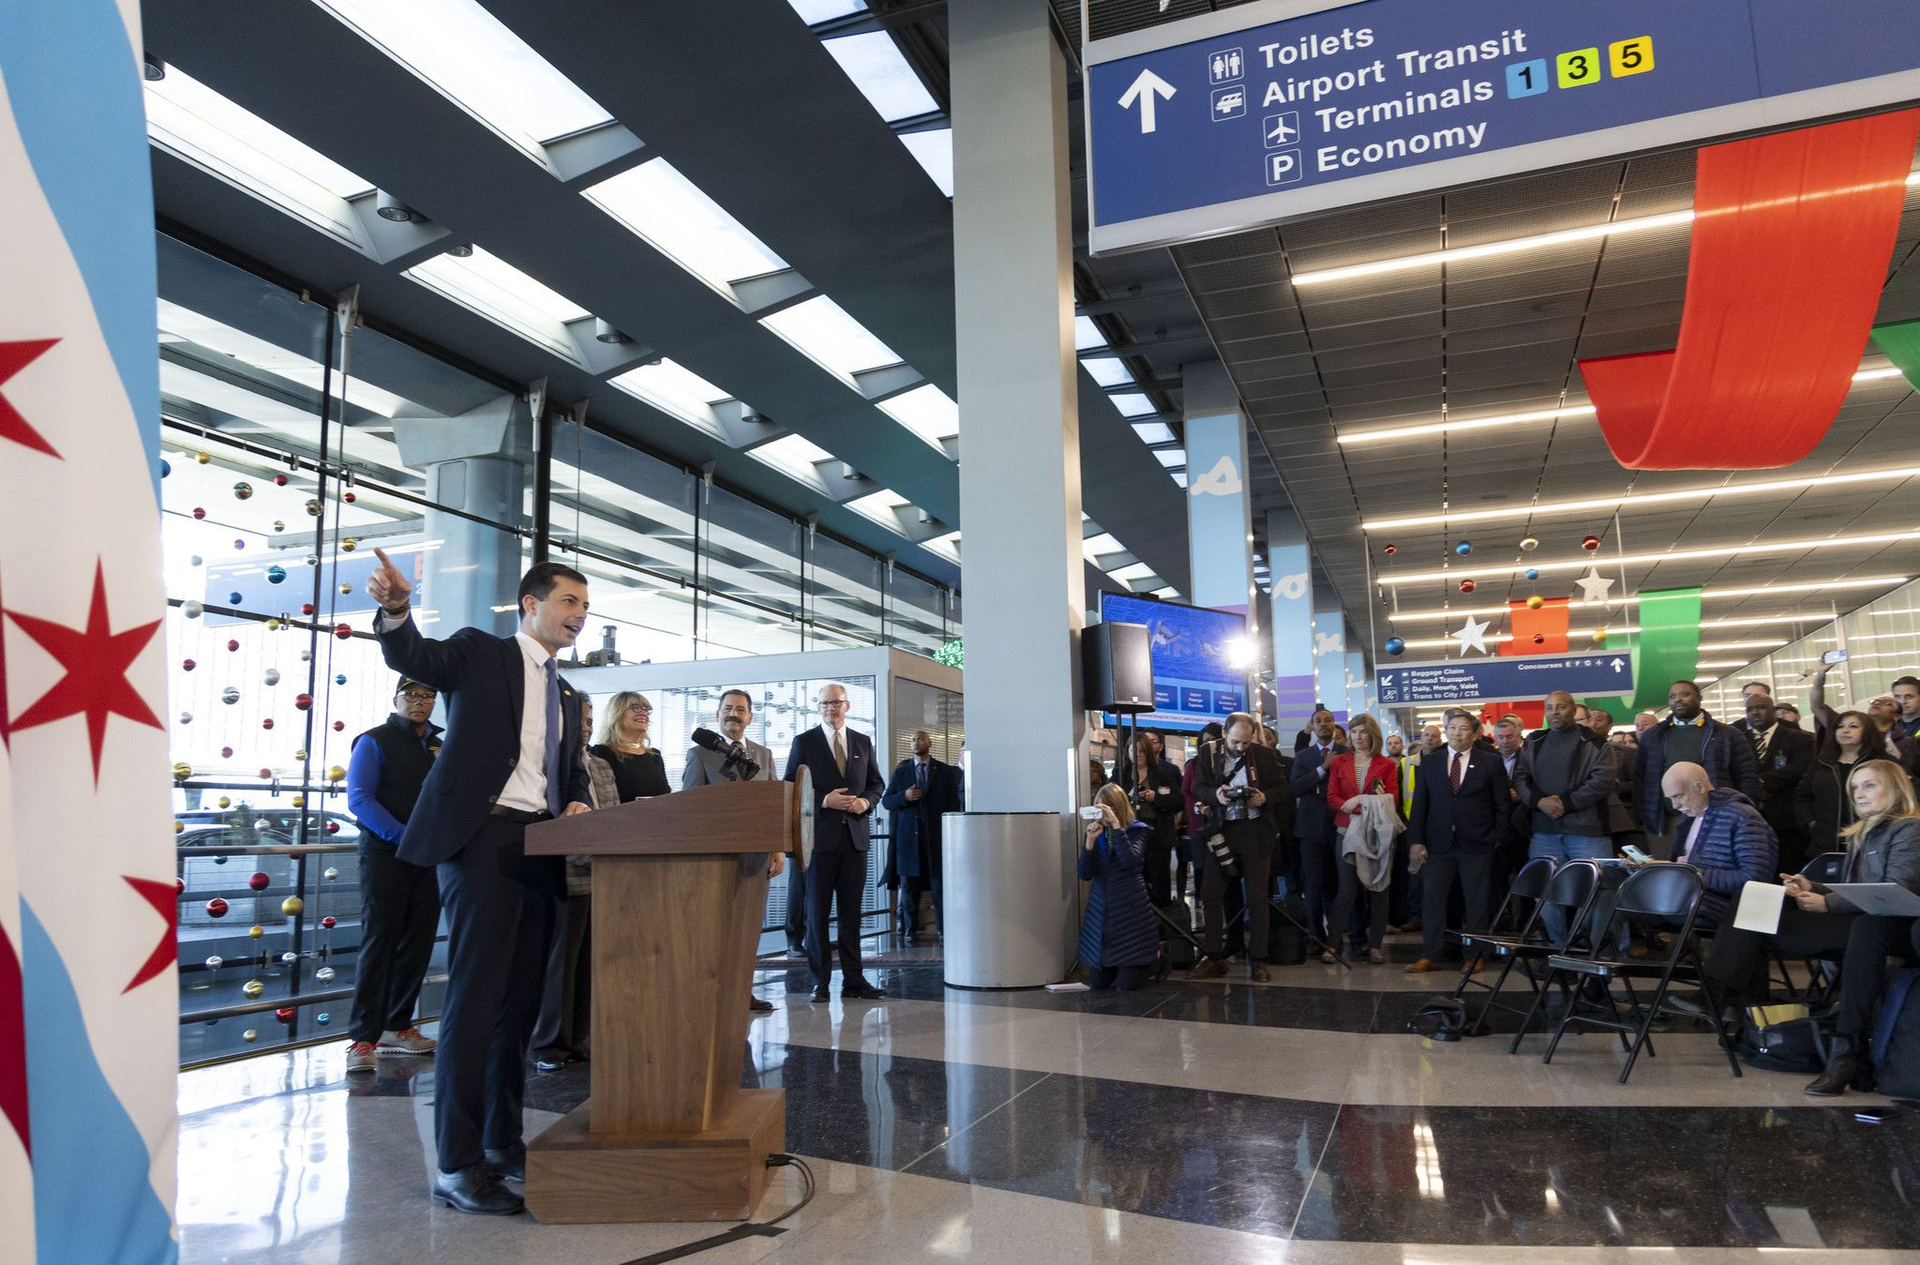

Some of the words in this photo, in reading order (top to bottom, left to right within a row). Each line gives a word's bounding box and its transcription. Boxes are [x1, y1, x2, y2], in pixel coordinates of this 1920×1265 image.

[1258, 26, 1375, 70] Toilets
[1261, 61, 1386, 109] Airport
[1397, 28, 1527, 78] Transit
[1315, 80, 1494, 134] Terminals
[1519, 67, 1533, 90] 1
[1567, 56, 1588, 80] 3
[1621, 42, 1642, 69] 5
[1273, 155, 1294, 180] P
[1316, 121, 1488, 172] Economy
[1439, 675, 1474, 683] Transport
[1518, 663, 1563, 671] Concourses
[1412, 685, 1432, 693] Daily,
[1433, 684, 1459, 692] Hourly,
[1443, 691, 1458, 699] City
